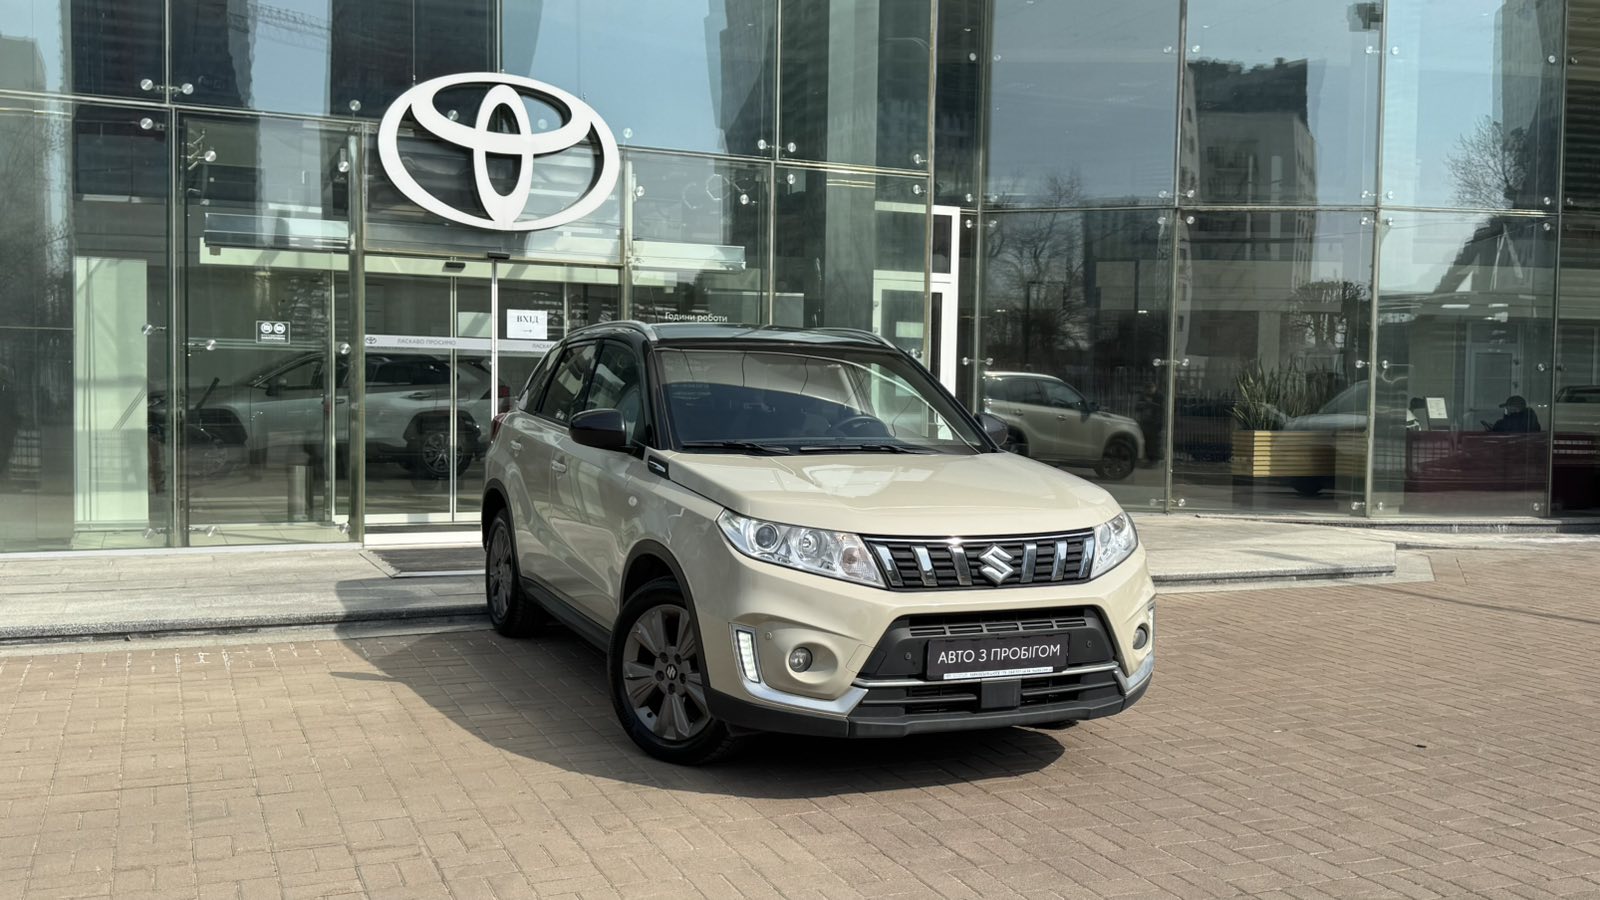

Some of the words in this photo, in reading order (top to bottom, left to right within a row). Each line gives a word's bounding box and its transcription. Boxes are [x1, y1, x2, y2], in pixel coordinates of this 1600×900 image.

[516, 315, 539, 324] ВХІД
[664, 312, 696, 321] Години
[697, 313, 728, 323] роботи
[937, 650, 975, 664] АВТО
[978, 649, 988, 662] З
[990, 644, 1061, 661] ПРОБІГОМ
